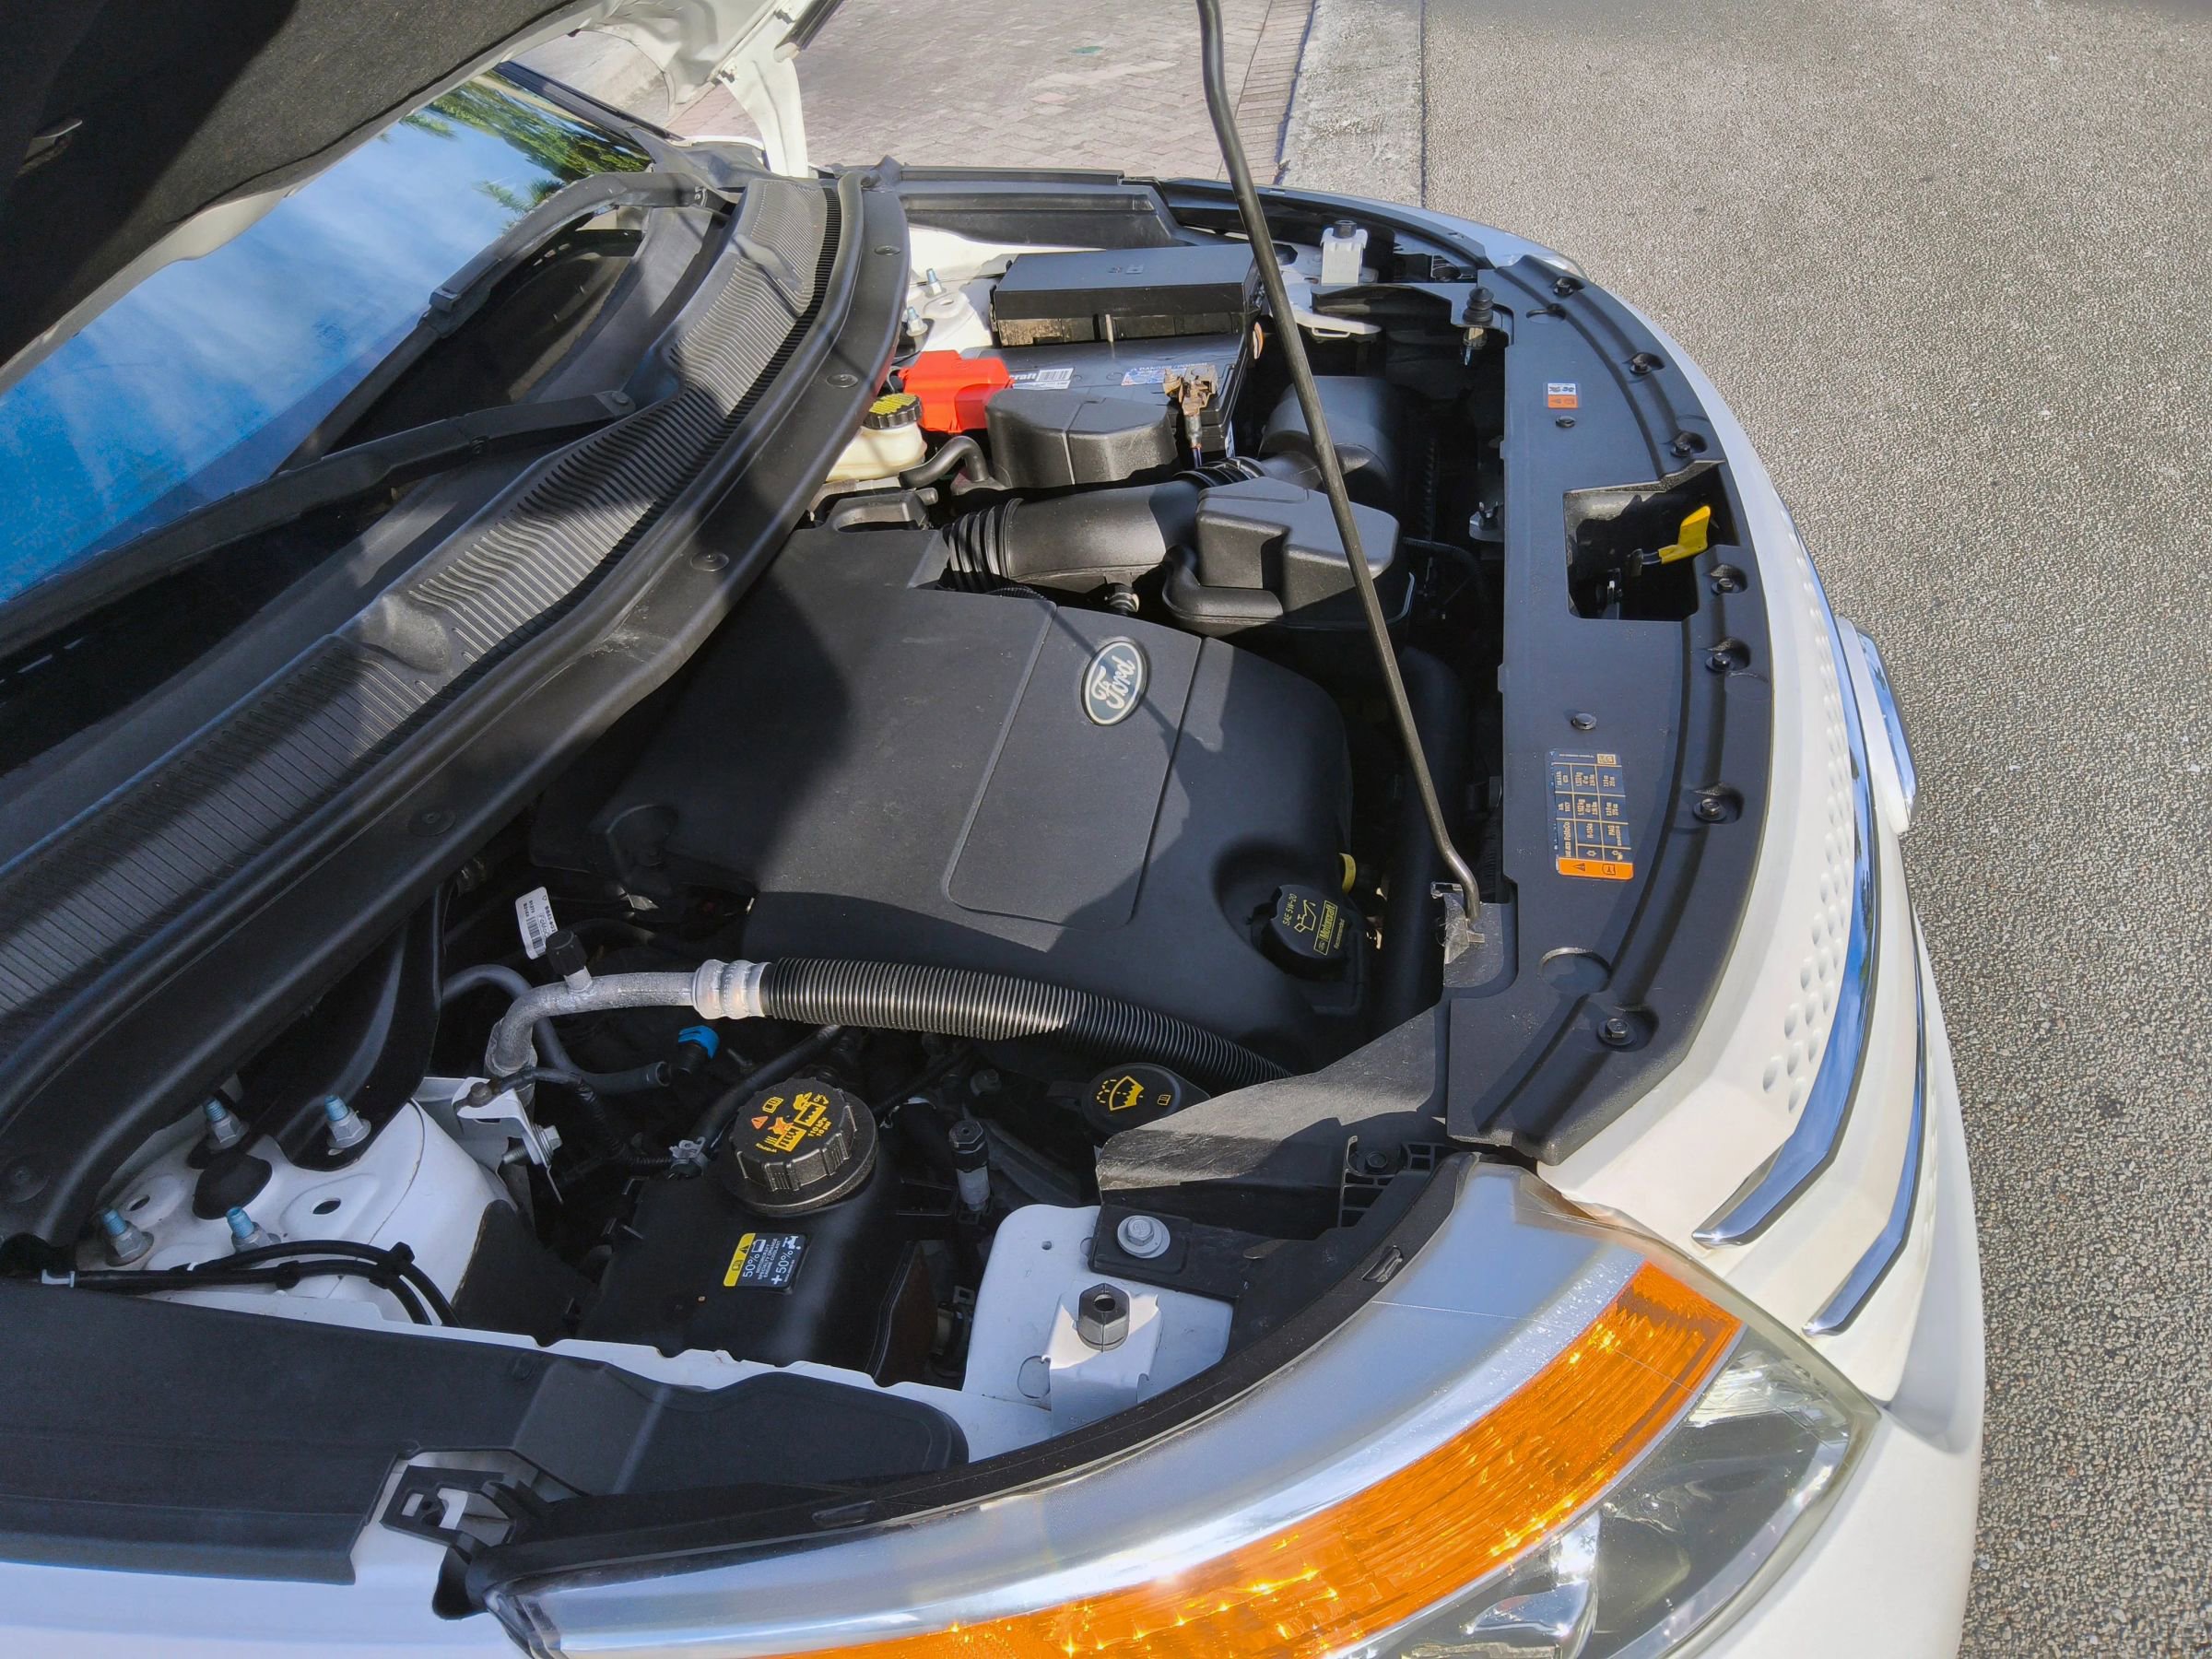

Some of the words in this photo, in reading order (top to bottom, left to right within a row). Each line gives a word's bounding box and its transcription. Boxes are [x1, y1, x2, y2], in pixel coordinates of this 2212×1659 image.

[1091, 655, 1135, 709] Ford
[1286, 893, 1297, 913] 5W-20
[1282, 912, 1292, 926] SAE
[1319, 903, 1335, 940] Motorcraft
[743, 1253, 759, 1277] 50%
